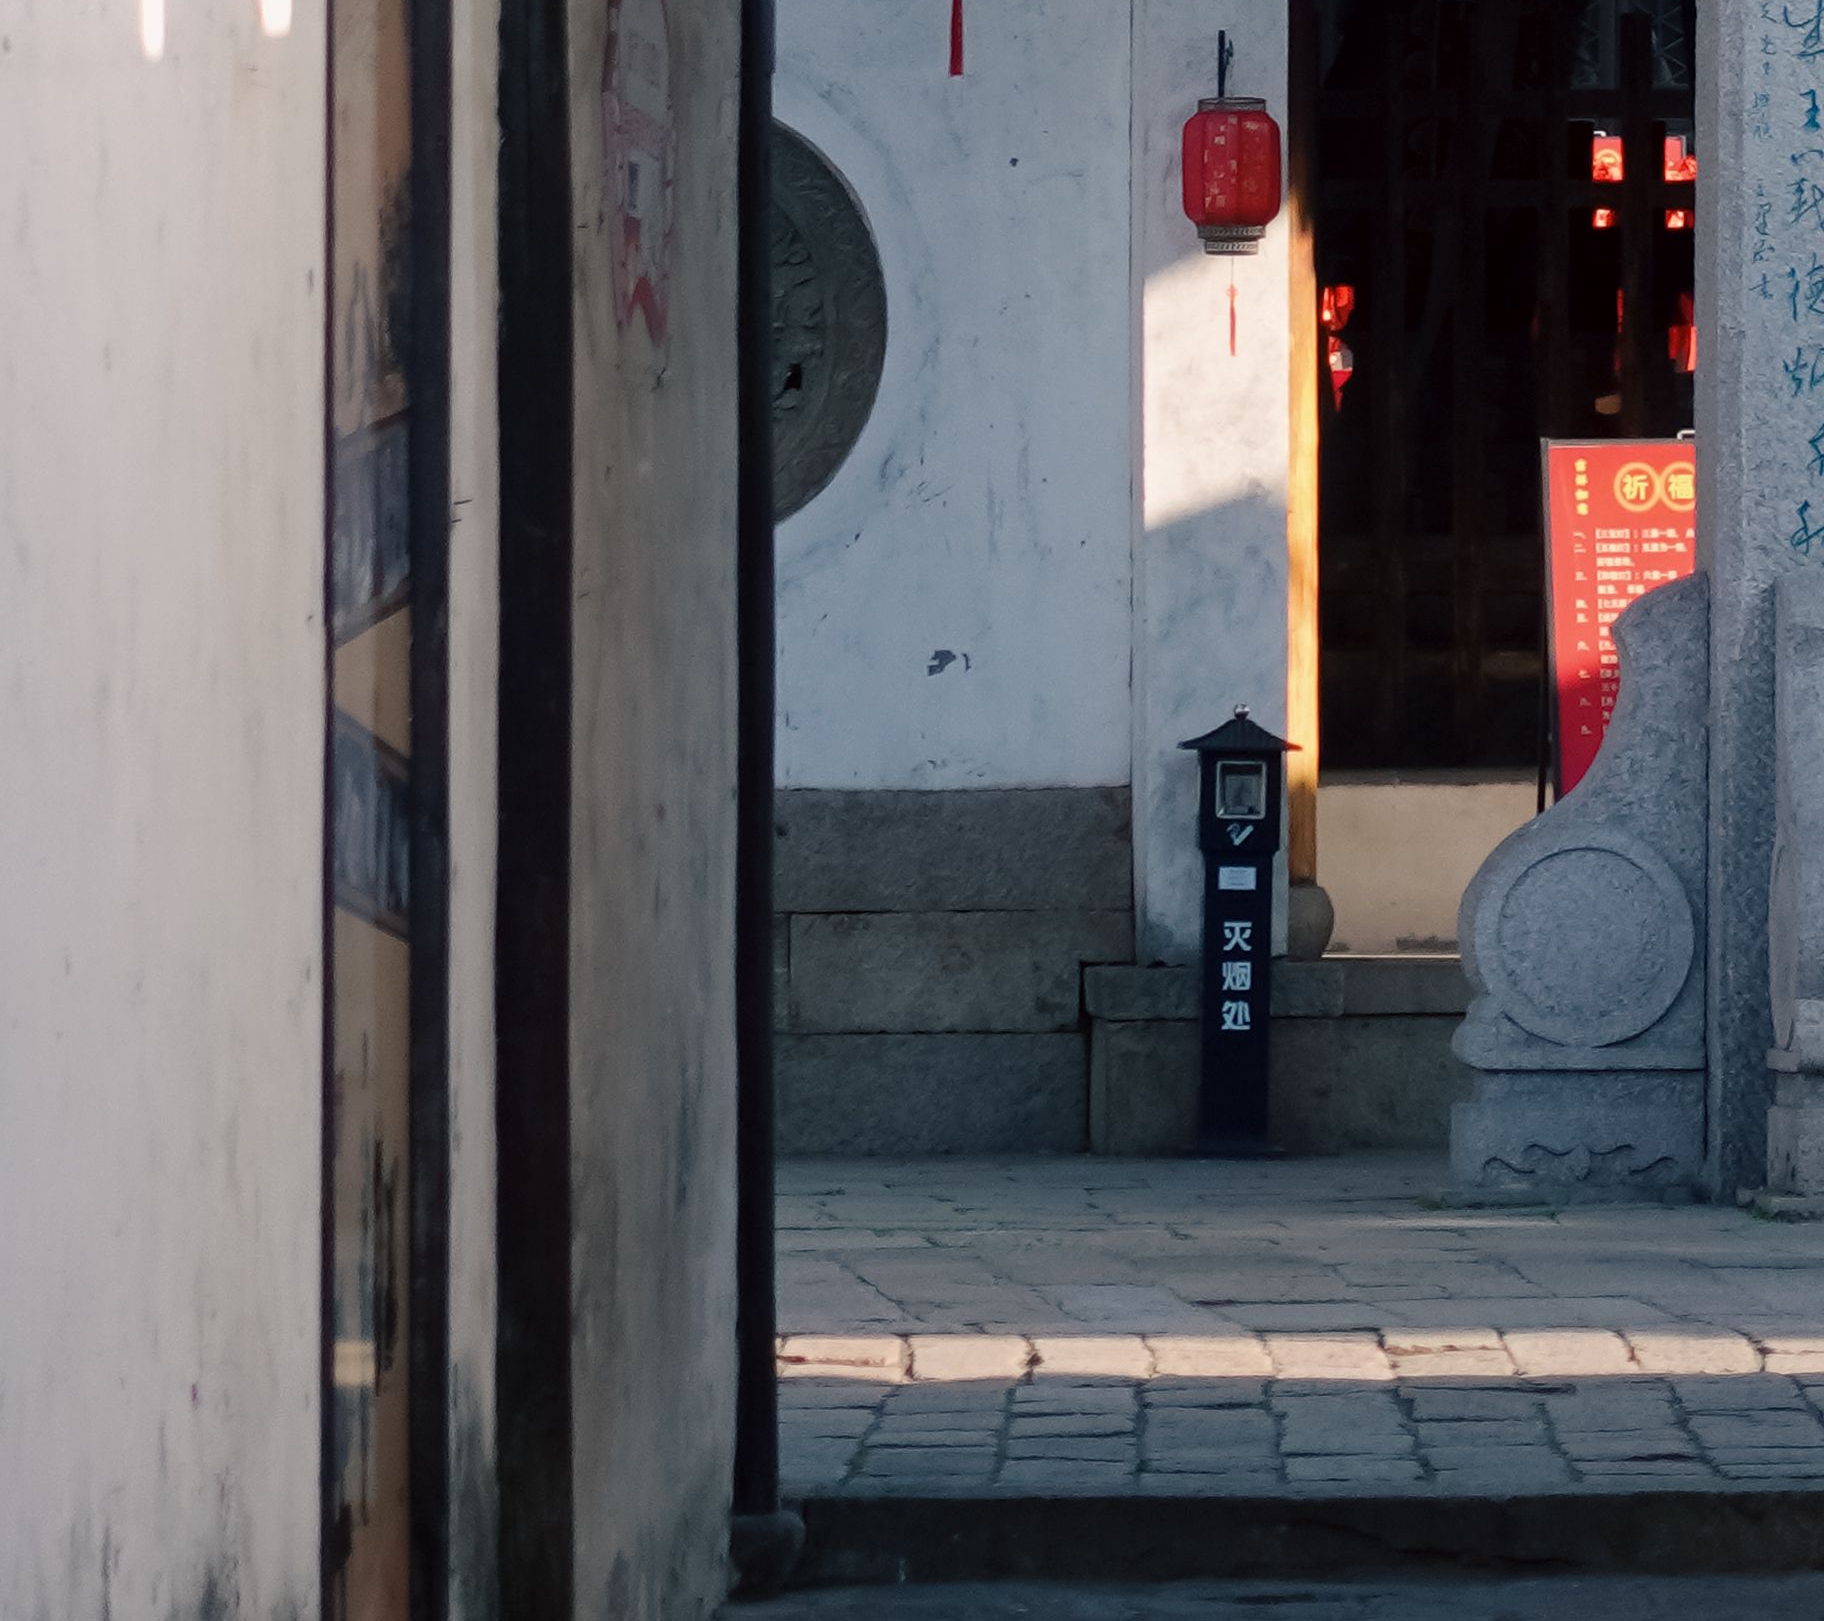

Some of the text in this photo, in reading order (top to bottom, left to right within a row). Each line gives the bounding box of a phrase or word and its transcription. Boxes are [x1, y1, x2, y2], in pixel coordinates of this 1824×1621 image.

[1622, 474, 1695, 500] 祈福
[1222, 921, 1252, 1030] 灭烟处
